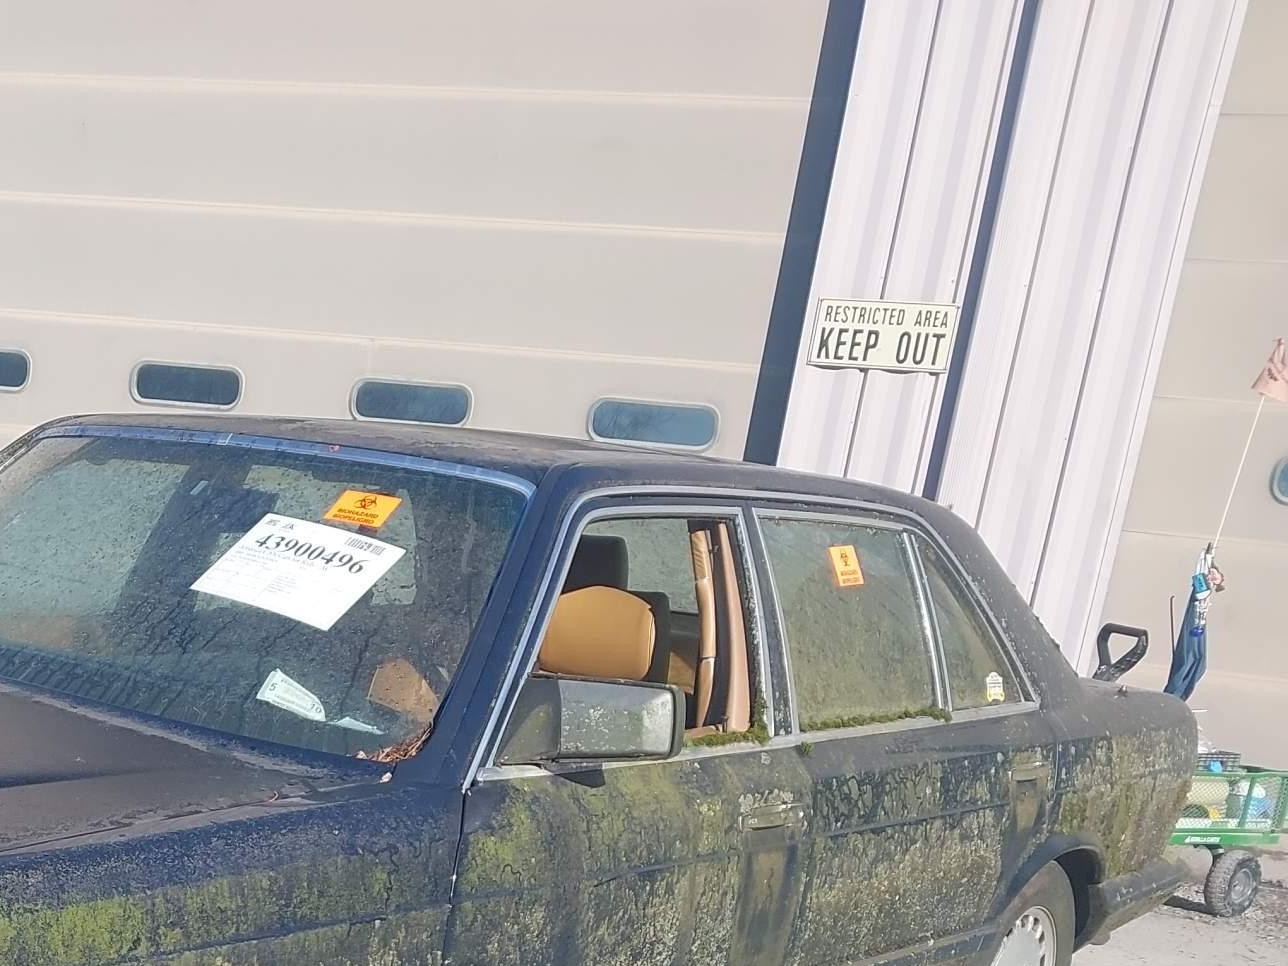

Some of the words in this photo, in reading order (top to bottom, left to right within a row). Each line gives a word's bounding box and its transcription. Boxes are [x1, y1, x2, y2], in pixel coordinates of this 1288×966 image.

[824, 305, 906, 326] RESTRICTED
[914, 309, 949, 329] AREA
[816, 326, 880, 362] KEEP
[895, 331, 946, 366] OUT
[255, 533, 369, 574] 43900496
